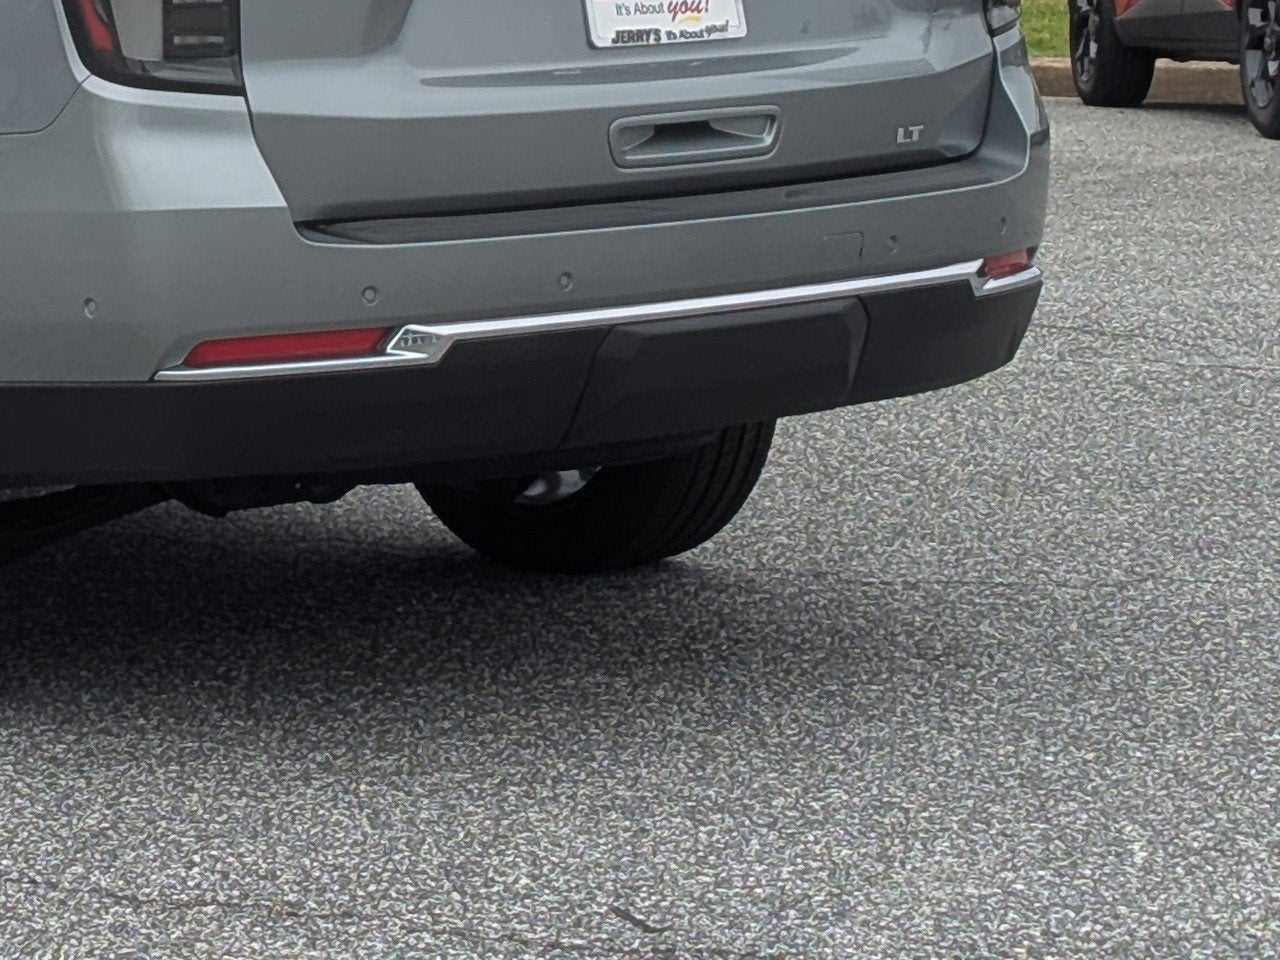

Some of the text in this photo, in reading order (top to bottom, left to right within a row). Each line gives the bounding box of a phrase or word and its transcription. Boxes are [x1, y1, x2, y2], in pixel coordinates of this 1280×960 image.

[615, 3, 631, 17] It's
[634, 1, 665, 16] About
[610, 28, 662, 44] JERRY'S
[896, 124, 925, 144] LT
